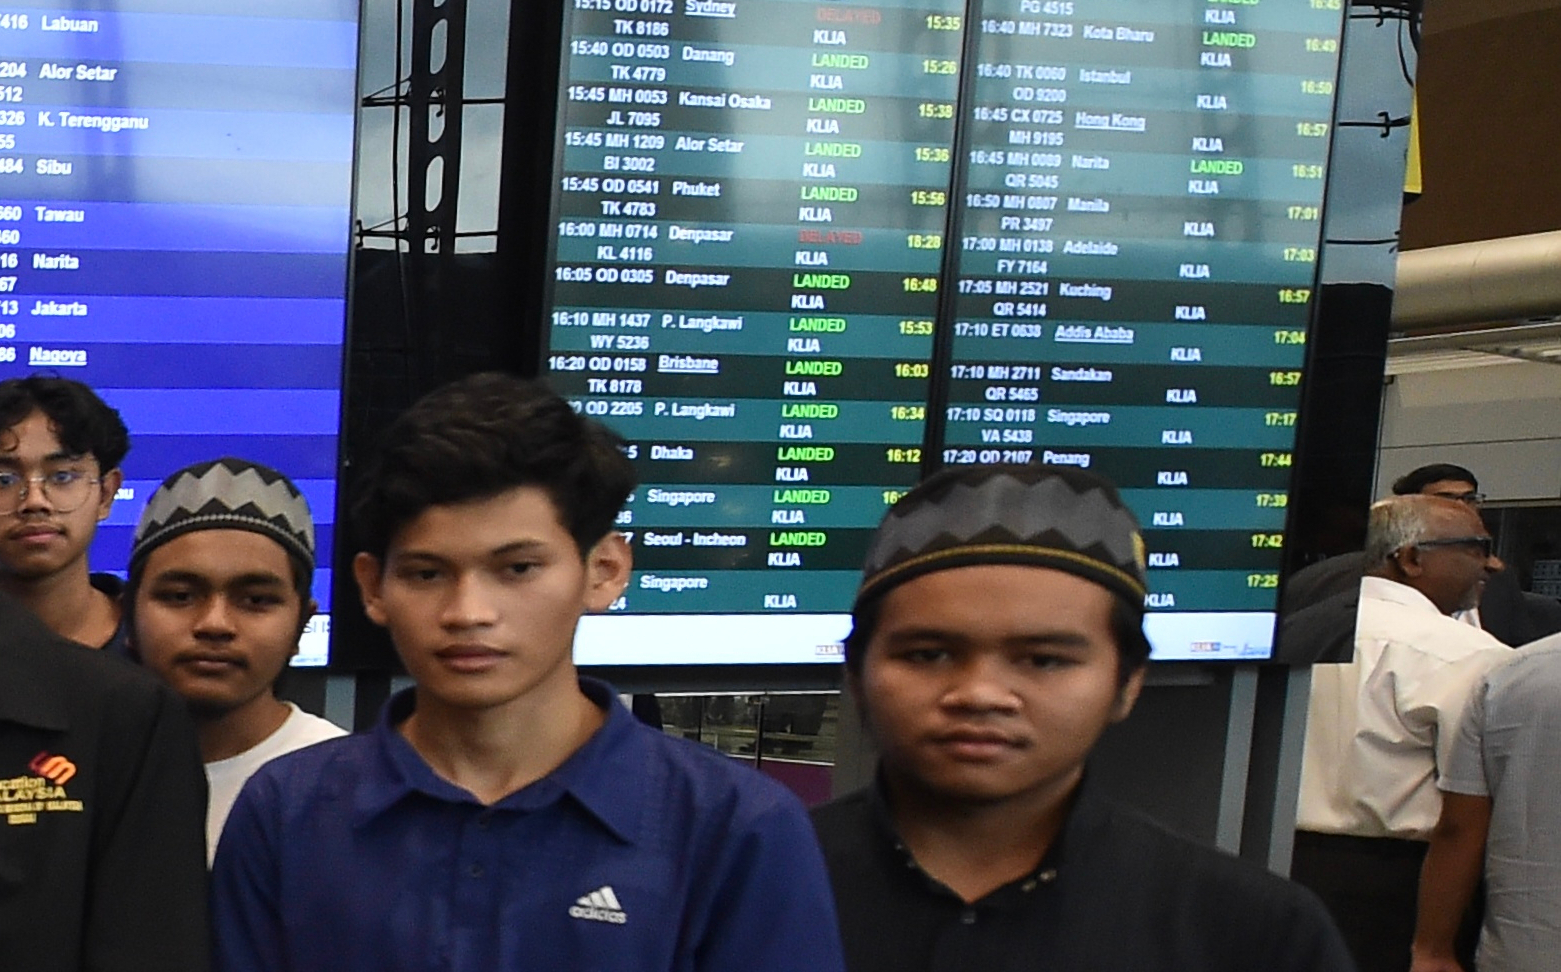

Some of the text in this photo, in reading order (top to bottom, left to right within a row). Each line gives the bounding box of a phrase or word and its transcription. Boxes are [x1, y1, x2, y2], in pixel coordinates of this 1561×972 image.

[1084, 25, 1113, 39] Kota
[1204, 32, 1256, 47] LANDED
[571, 41, 608, 55] 15:40
[612, 43, 634, 57] OD
[637, 44, 669, 58] 0503
[683, 47, 734, 65] Danang
[812, 54, 868, 68] LANDED
[39, 64, 73, 79] Alor
[76, 65, 117, 80] Setar
[811, 75, 842, 88] KLIA
[679, 92, 953, 118] Kansai Osaka LANDED 15:38
[39, 112, 149, 131] K. Terengganu
[37, 159, 71, 174] Sibu
[35, 206, 84, 222] Tawau
[33, 254, 79, 269] Narita
[662, 314, 933, 334] P. Langkawi LANDED 15:53
[1056, 325, 1133, 340] Addis Ababa
[29, 347, 87, 366] Nagoya
[1171, 348, 1201, 361] KLIA
[658, 355, 928, 377] Brisbane LANDED 16:03
[1048, 409, 1296, 425] Singapore 17:17
[651, 446, 921, 462] Dhaka LANDED 16:12
[1043, 451, 1291, 467] Penang 17:44
[776, 468, 808, 481] KLIA
[1158, 472, 1187, 485] KLIA
[644, 532, 826, 546] Seoul Incheon LANDED
[1252, 534, 1282, 547] 17:42
[569, 906, 627, 924] adidas
